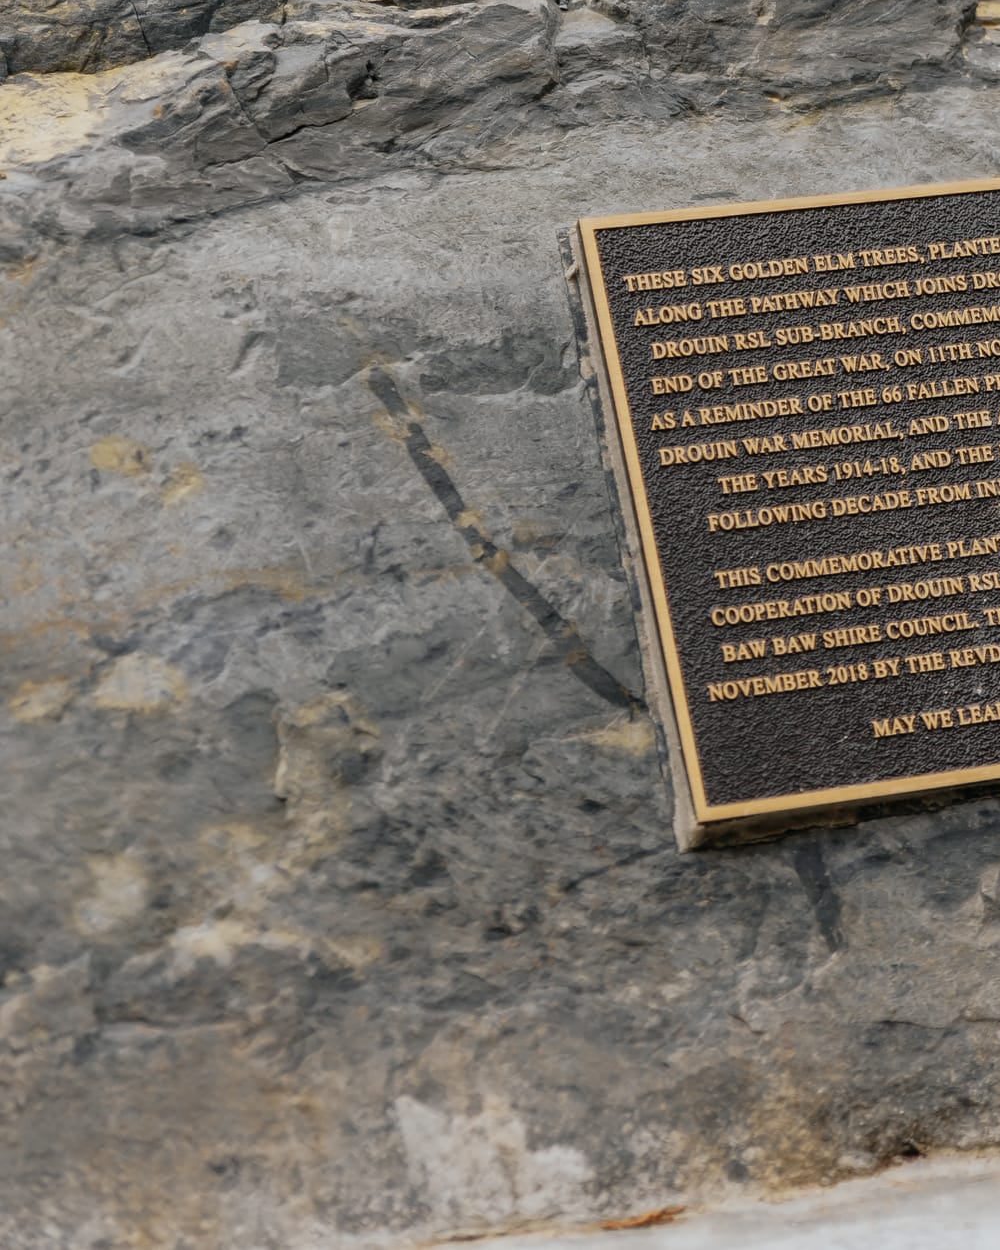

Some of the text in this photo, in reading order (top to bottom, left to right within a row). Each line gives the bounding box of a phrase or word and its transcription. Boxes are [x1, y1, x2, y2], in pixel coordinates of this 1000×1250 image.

[623, 269, 688, 291] THESE
[691, 265, 725, 284] SIX
[729, 255, 809, 280] GOLDEN
[812, 251, 856, 271] ELM
[858, 245, 925, 266] TREES,
[634, 301, 702, 326] ALONG
[706, 298, 746, 317] THE
[749, 288, 839, 313] PATHWAY
[843, 279, 911, 302] WHICH
[915, 273, 968, 295] JOINS
[650, 334, 729, 359] DROUIN
[733, 330, 771, 349] RSL
[775, 315, 906, 345] SUB-BRANCH,
[650, 374, 694, 394] END
[698, 369, 722, 388] OF
[727, 365, 768, 385] THE
[773, 357, 836, 380] GREAT
[839, 352, 892, 372] WAR,
[894, 349, 922, 366] ON
[928, 341, 974, 362] 11TH
[651, 410, 676, 430] AS
[681, 409, 696, 427] A
[698, 397, 804, 424] REMINDER
[808, 392, 832, 411] OF
[837, 387, 877, 407] THE
[882, 384, 902, 403] 66
[905, 376, 980, 400] FALLEN
[658, 440, 739, 465] DROUIN
[741, 433, 788, 454] WAR
[790, 421, 905, 449] MEMORIAL,
[909, 415, 950, 435] AND
[953, 409, 992, 429] THE
[717, 472, 758, 493] THE
[761, 464, 829, 488] YEARS
[834, 455, 907, 479] 1914-18,
[910, 449, 952, 470] AND
[955, 444, 994, 464] THE
[707, 500, 826, 531] FOLLOWING
[830, 490, 911, 516] DECADE
[914, 481, 973, 505] FROM
[714, 565, 761, 588] THIS
[766, 542, 942, 581] COMMEMORATIVE
[711, 591, 852, 625] COOPERATION
[856, 587, 882, 606] OF
[886, 575, 964, 602] DROUIN
[720, 639, 766, 661] BAW
[771, 632, 817, 655] BAW
[822, 623, 883, 648] SHIRE
[886, 611, 980, 639] COUNCIL.
[707, 669, 823, 701] NOVEMBER
[826, 662, 868, 684] 2018
[872, 656, 899, 678] BY
[904, 650, 947, 673] THE
[871, 714, 915, 737] MAY
[920, 709, 953, 729] WE
